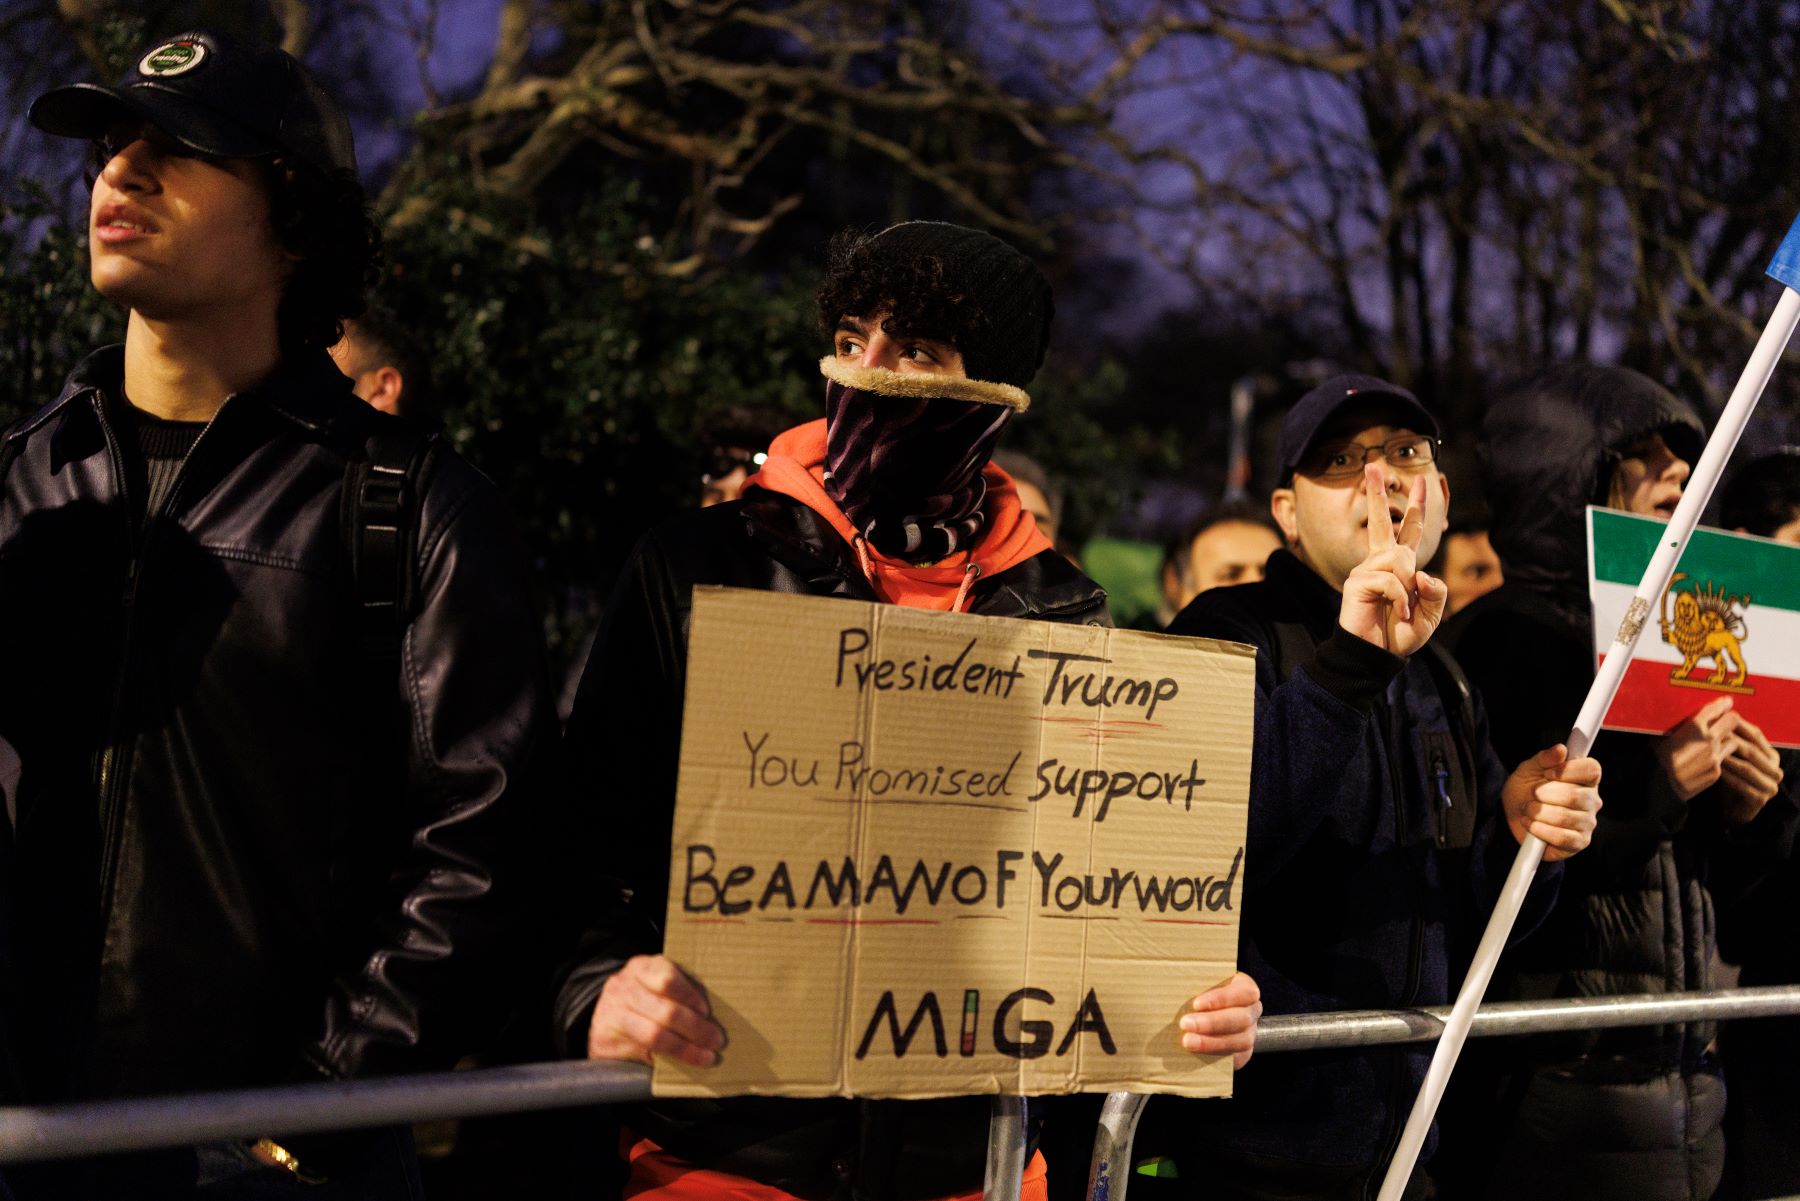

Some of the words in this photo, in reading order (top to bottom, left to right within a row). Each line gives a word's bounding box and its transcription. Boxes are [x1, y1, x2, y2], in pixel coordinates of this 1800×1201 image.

[835, 628, 1025, 698] President
[1027, 648, 1179, 720] Trump
[743, 731, 819, 789] You
[834, 741, 1022, 797] Promised
[1027, 759, 1206, 822] support
[758, 861, 796, 910] A
[803, 854, 951, 914] MAN
[1031, 850, 1134, 912] Your
[1132, 846, 1244, 913] word
[855, 987, 1117, 1059] MIGA
